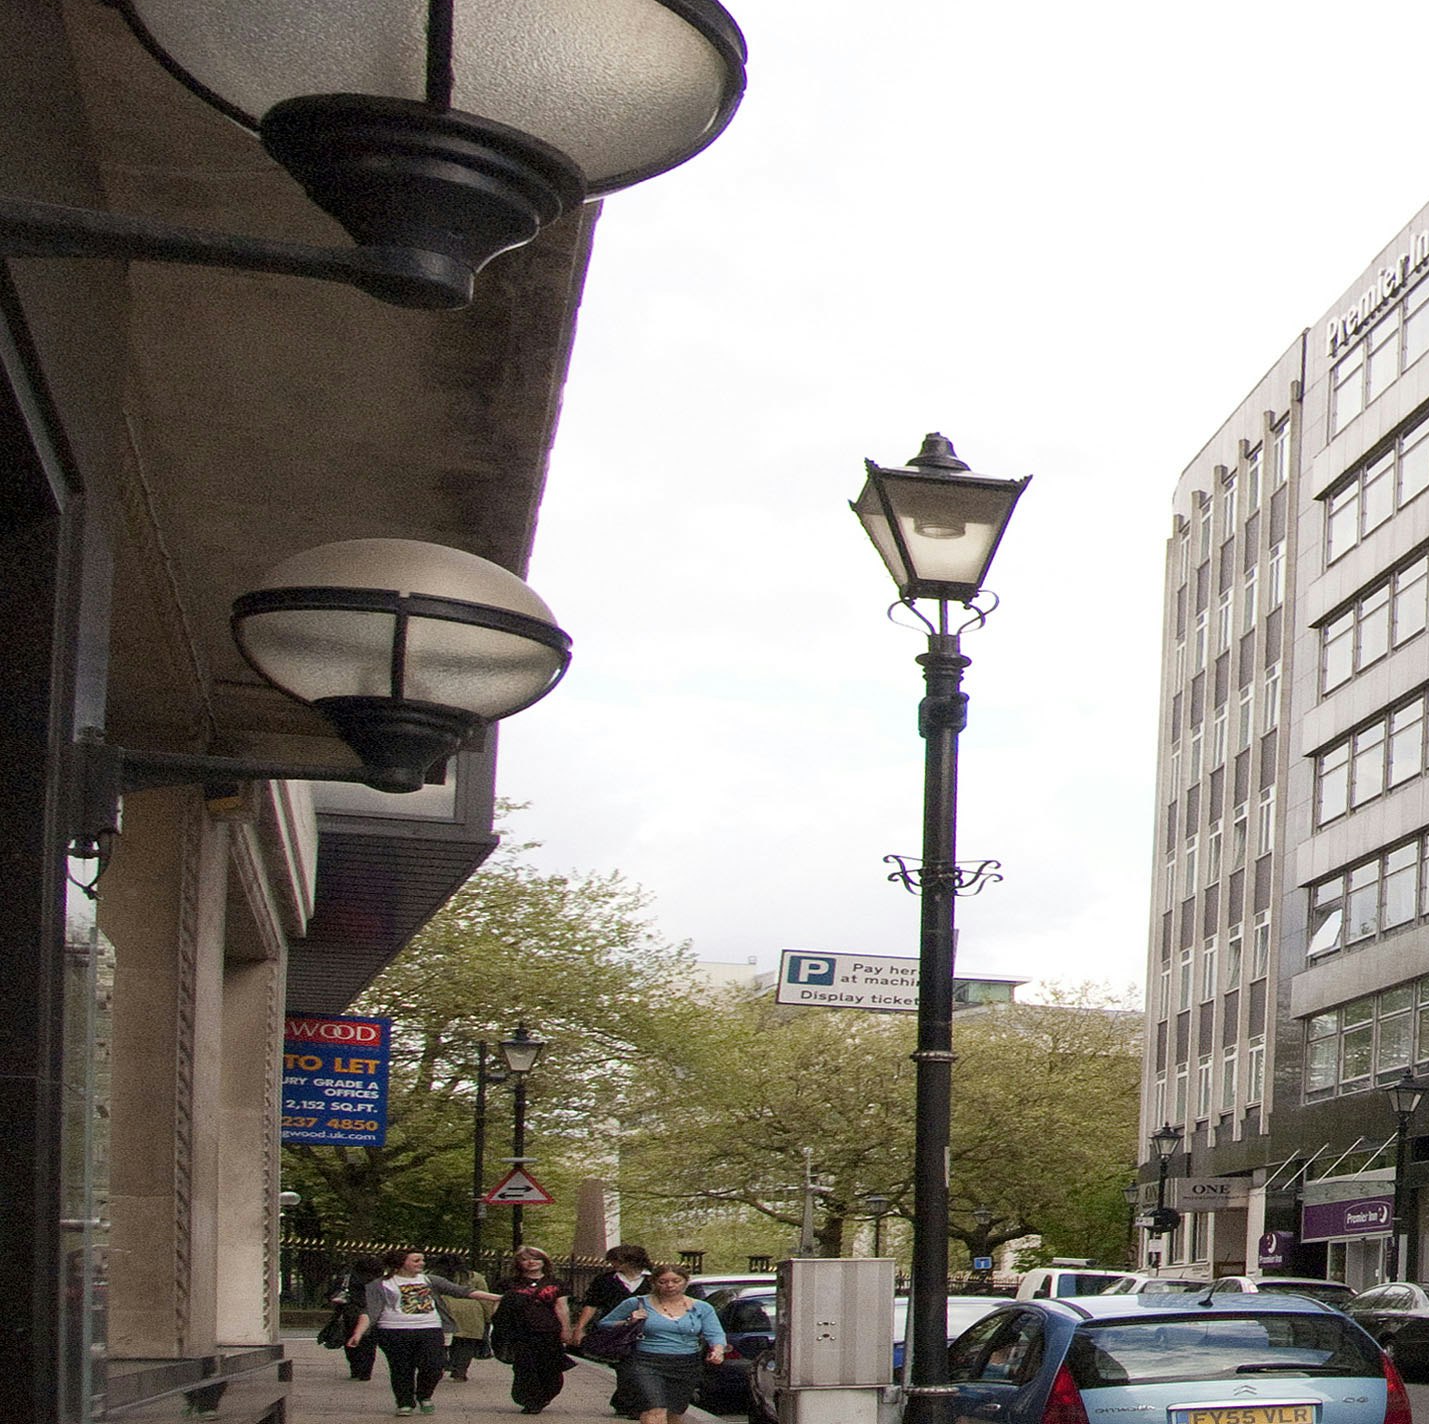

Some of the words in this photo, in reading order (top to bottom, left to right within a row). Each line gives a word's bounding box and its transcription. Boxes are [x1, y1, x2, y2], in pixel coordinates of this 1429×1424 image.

[1326, 253, 1410, 358] Premier
[798, 958, 830, 983] P
[852, 963, 884, 975] Pay
[889, 965, 919, 976] her
[841, 975, 858, 984] at
[864, 976, 919, 988] machi
[800, 990, 865, 1004] Display
[871, 994, 919, 1007] ticket
[286, 1022, 377, 1042] WOOD
[284, 1054, 323, 1071] TO
[333, 1057, 380, 1075] LET
[313, 1078, 363, 1089] GRADE
[367, 1082, 379, 1090] A
[324, 1088, 380, 1099] OFFICES
[286, 1099, 326, 1111] 2,152
[330, 1102, 378, 1113] SQ.FT.
[282, 1117, 318, 1128] 237
[326, 1118, 379, 1132] 4850
[282, 1130, 377, 1141] gwood.uk.com
[1192, 1184, 1232, 1195] ONE
[1346, 1211, 1369, 1225] Premier
[1263, 1408, 1308, 1424] VLR
